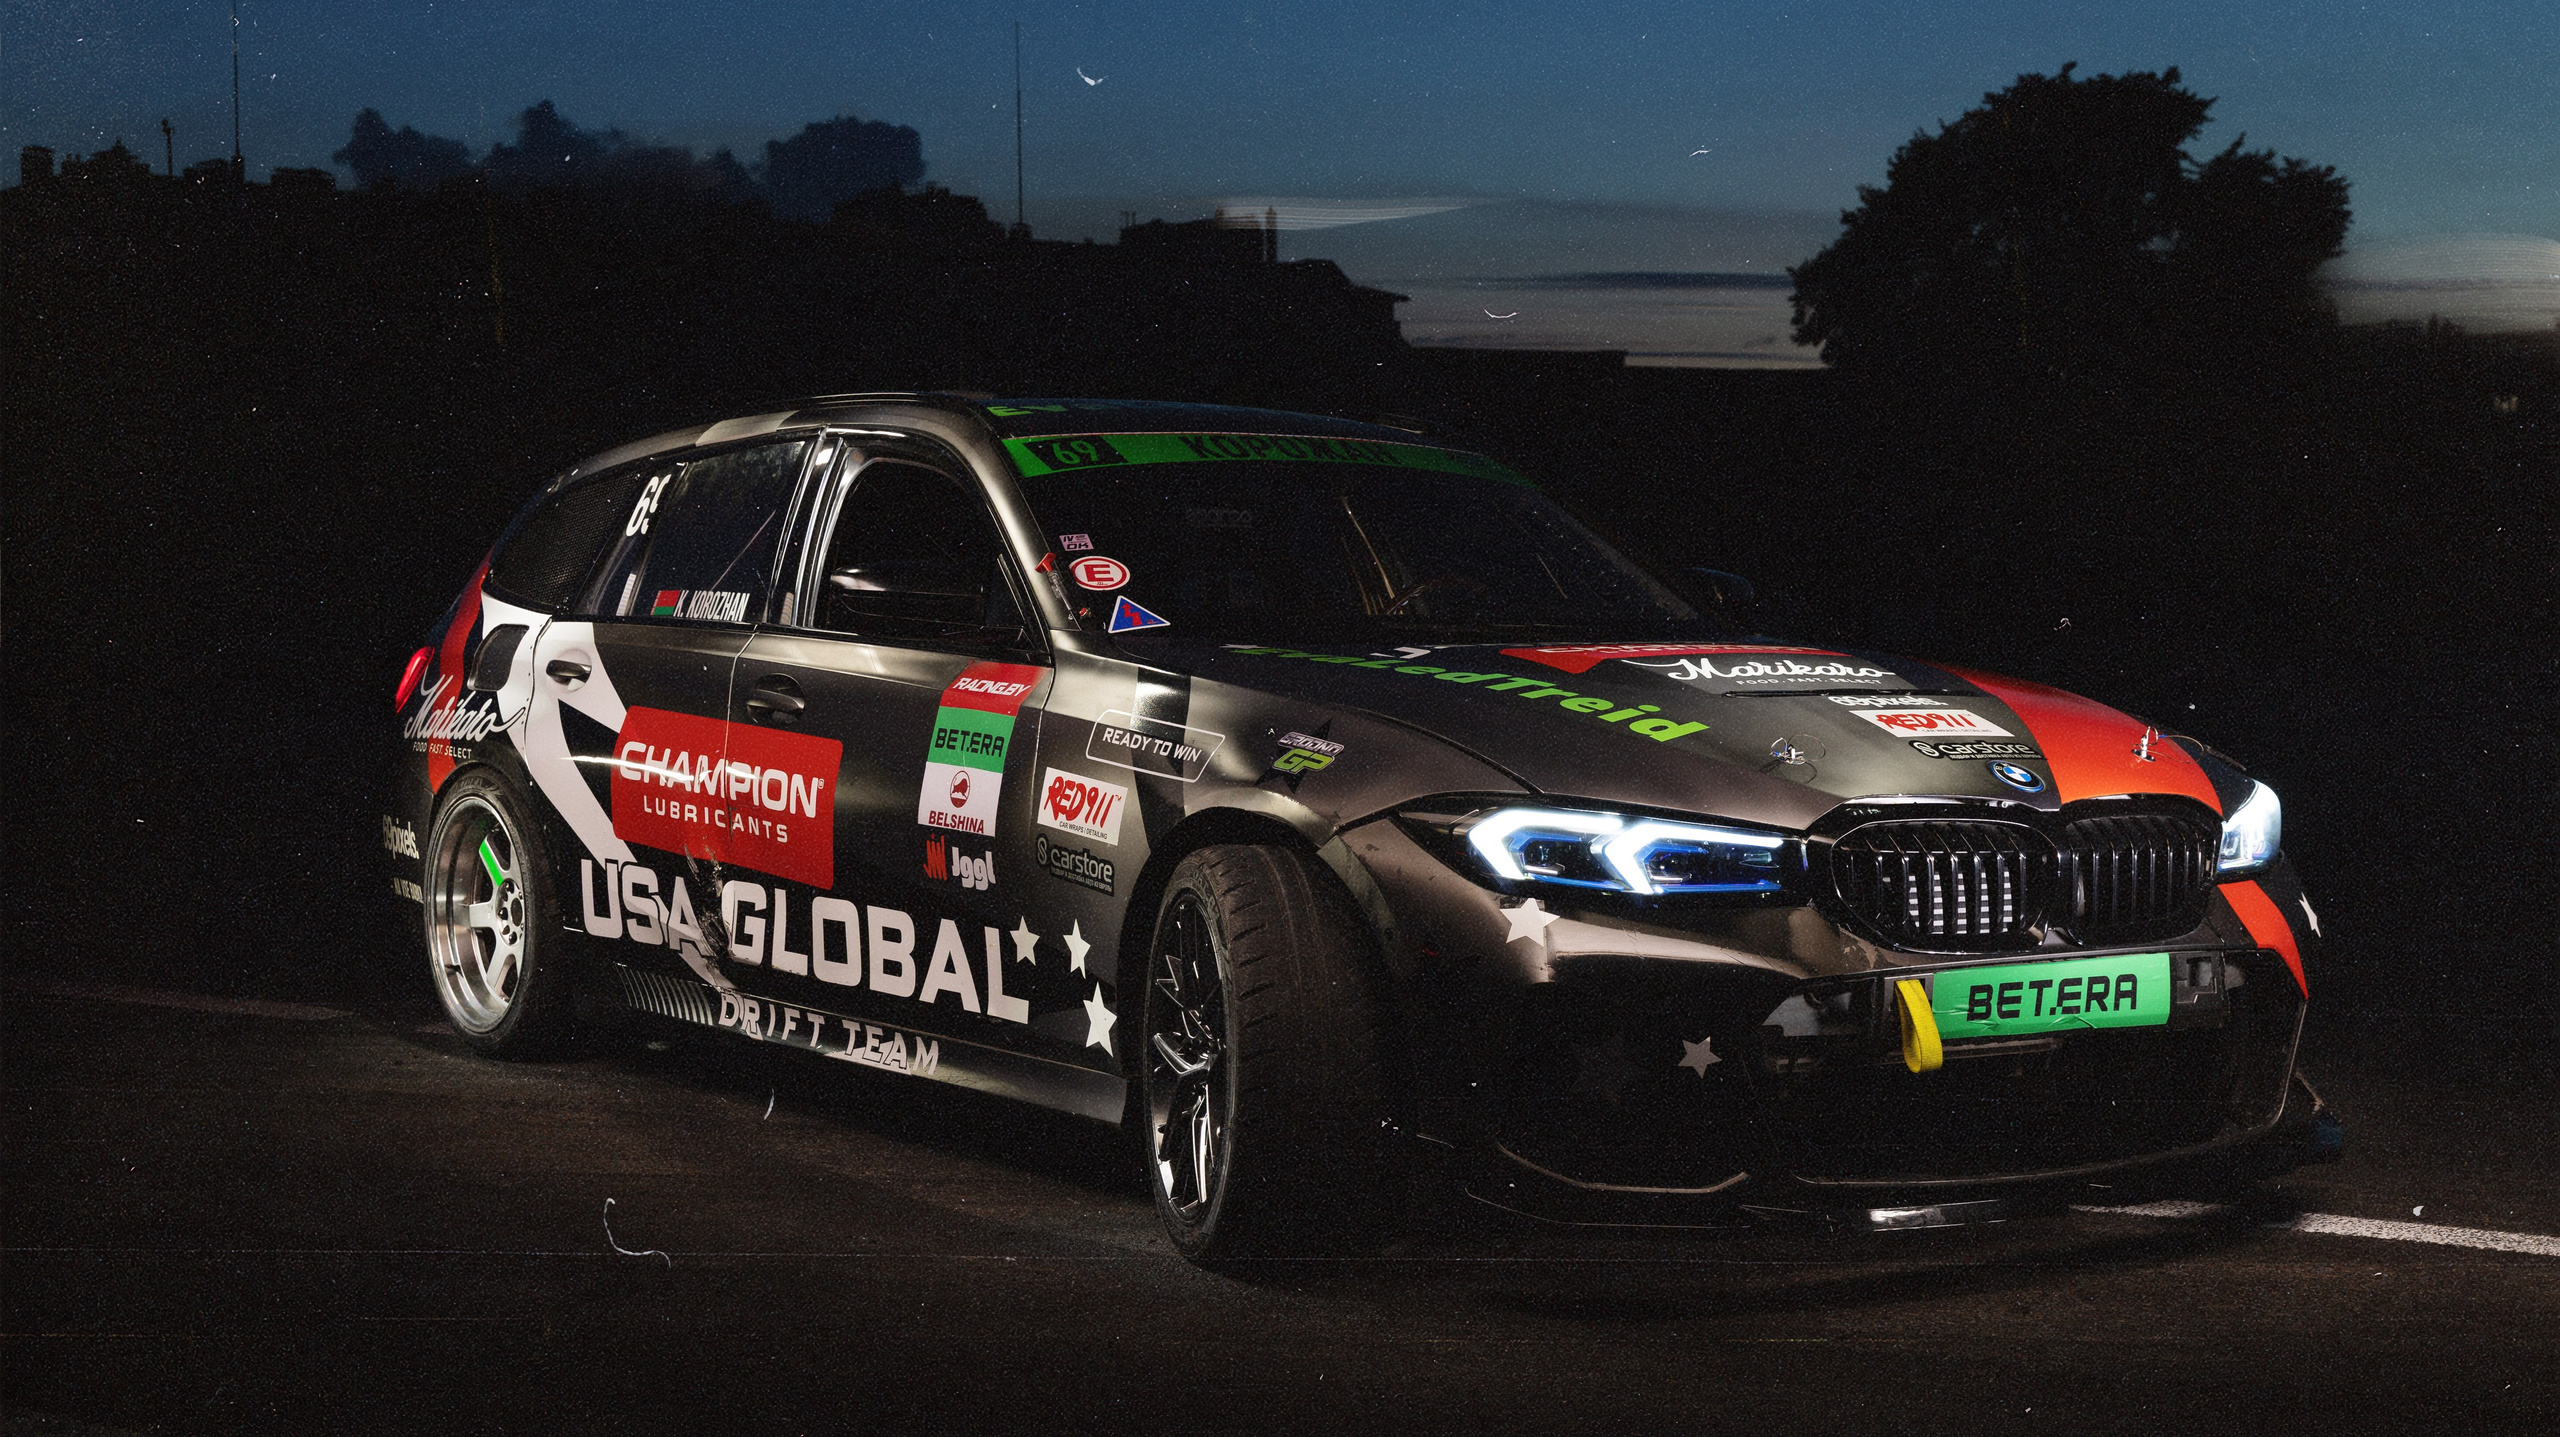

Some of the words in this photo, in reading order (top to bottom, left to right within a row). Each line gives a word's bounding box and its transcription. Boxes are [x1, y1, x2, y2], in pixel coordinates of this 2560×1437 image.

[1052, 439, 1099, 465] 69
[1067, 542, 1089, 550] OK
[1083, 564, 1115, 582] E
[673, 590, 690, 617] K.
[686, 590, 750, 622] KOROZHAN
[444, 745, 472, 759] SELECT
[1103, 727, 1152, 751] READY
[1153, 739, 1172, 756] TO
[1173, 744, 1202, 762] WIN
[1938, 741, 2035, 755] carstore
[1274, 748, 1334, 773] GP
[643, 795, 788, 843] LUBRICANTS
[928, 810, 985, 834] BELSHINA
[1050, 848, 1113, 883] carstore
[580, 858, 713, 958] USA
[723, 879, 1030, 1025] GLOBAL
[717, 992, 826, 1047] DRIFT
[842, 1019, 940, 1075] TEAM
